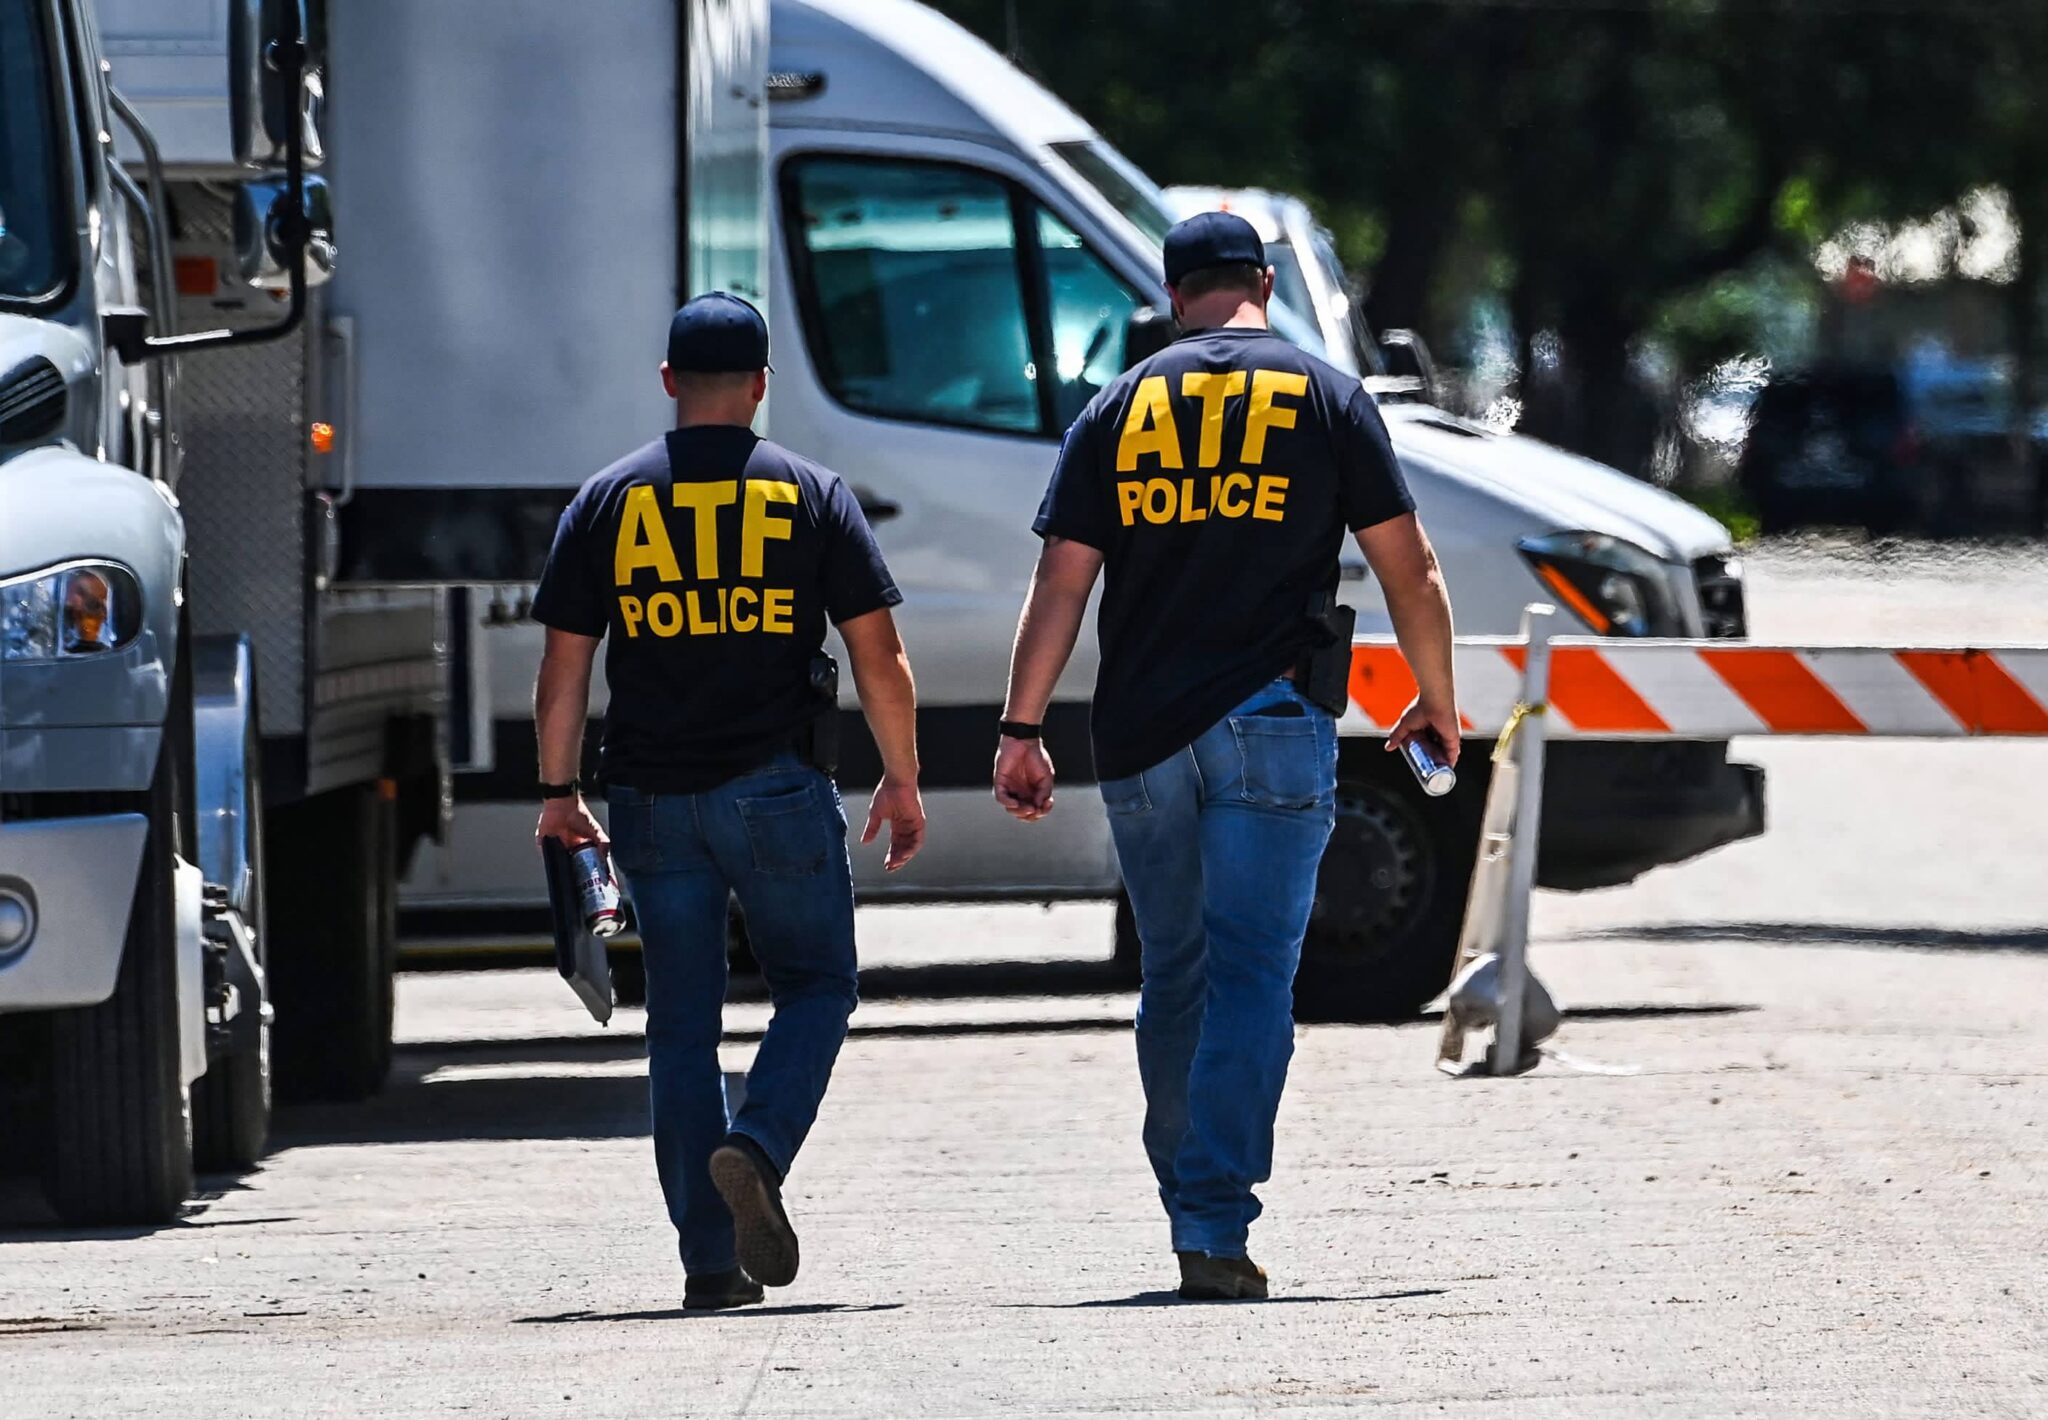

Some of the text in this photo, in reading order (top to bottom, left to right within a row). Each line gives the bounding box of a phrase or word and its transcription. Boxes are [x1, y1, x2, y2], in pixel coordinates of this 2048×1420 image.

[1116, 369, 1307, 472] ATF
[614, 479, 799, 586] ATF
[1117, 473, 1290, 526] POLICE
[619, 587, 794, 638] POLICE
